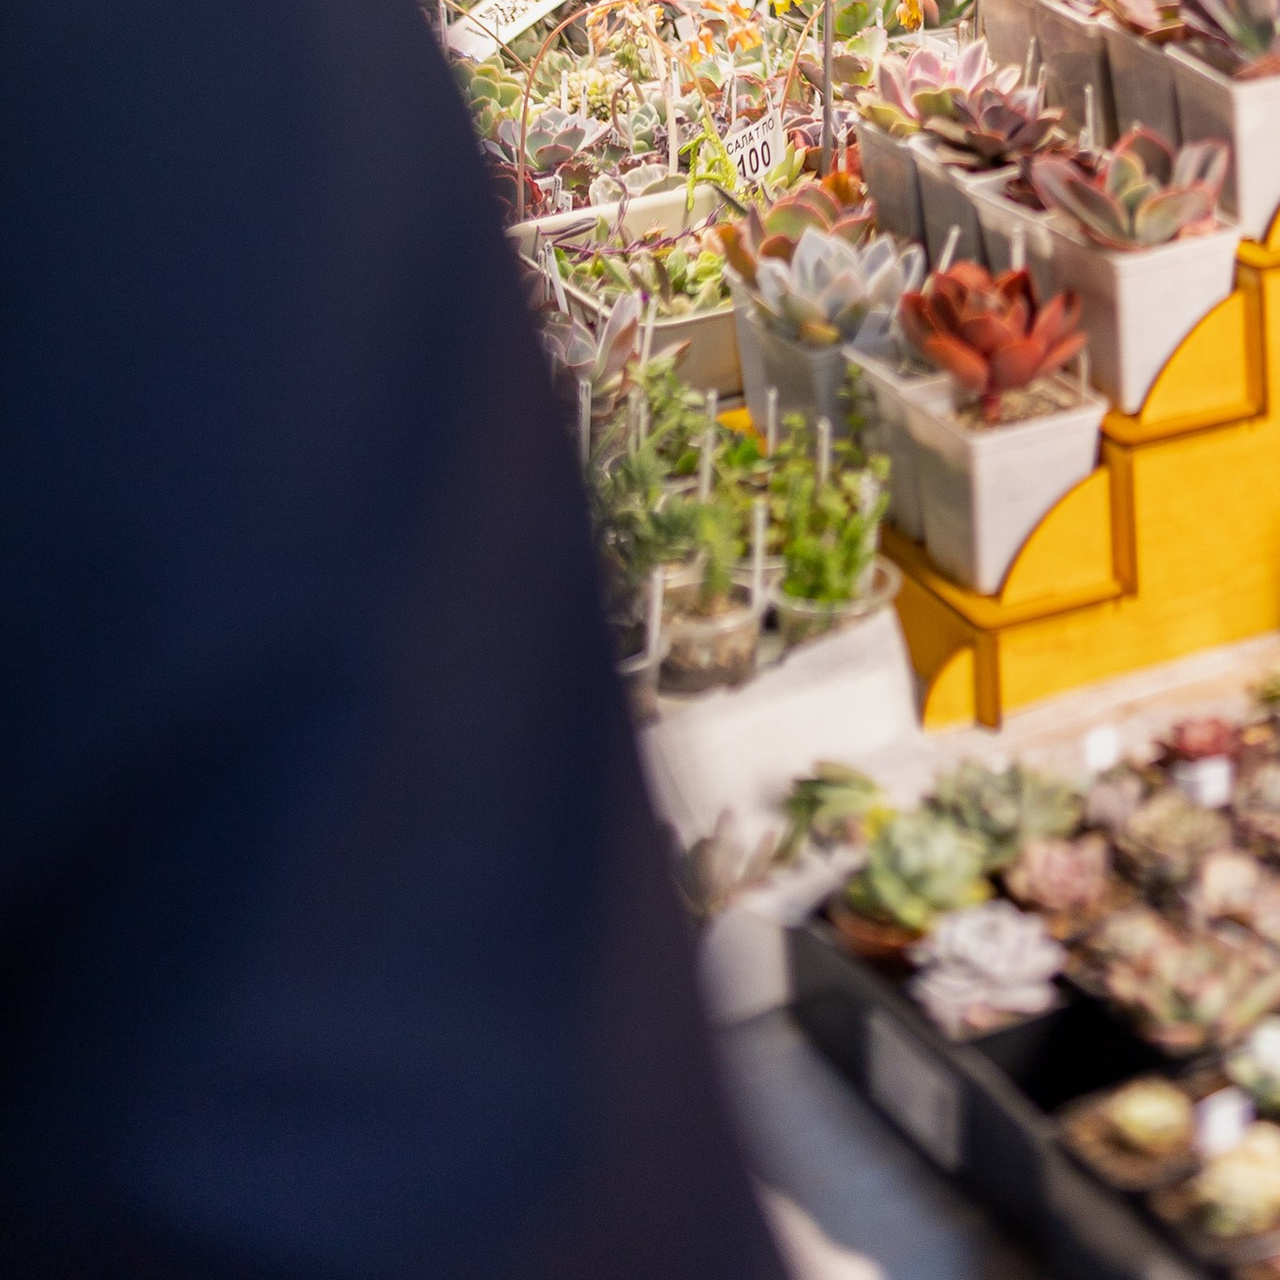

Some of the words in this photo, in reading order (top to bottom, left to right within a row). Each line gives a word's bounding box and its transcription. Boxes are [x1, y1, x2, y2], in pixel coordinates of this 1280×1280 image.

[726, 125, 761, 155] САЛАТ
[761, 117, 775, 136] ПО
[737, 140, 771, 178] 100
